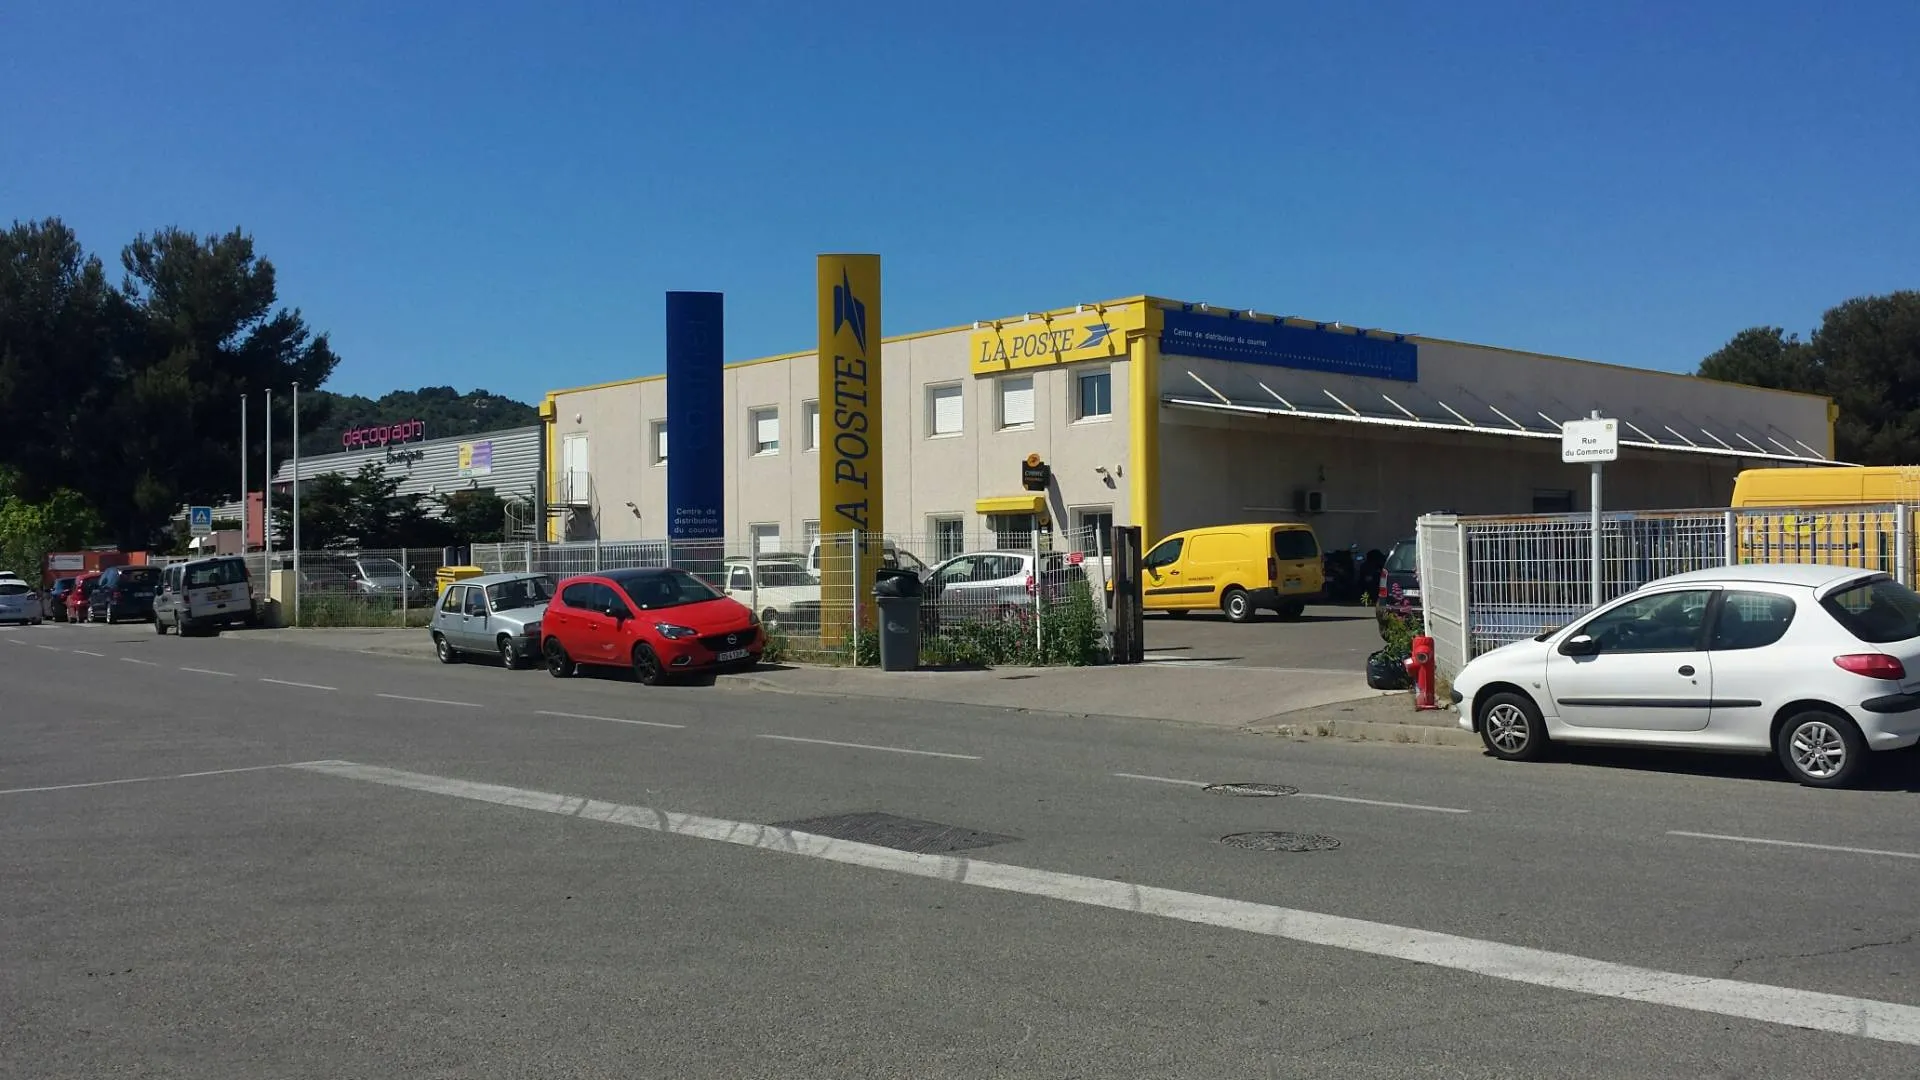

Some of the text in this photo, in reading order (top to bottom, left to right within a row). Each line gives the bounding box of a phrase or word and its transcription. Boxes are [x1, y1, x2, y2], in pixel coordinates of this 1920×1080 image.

[1173, 328, 1192, 338] Centre
[1205, 332, 1236, 343] distribution
[1237, 336, 1245, 344] du
[980, 328, 1075, 363] LA POSTE
[834, 355, 868, 490] POSTE
[342, 417, 423, 447] décograph
[1576, 448, 1614, 456] Commerce
[676, 507, 702, 515] Centre
[674, 517, 718, 525] distribution
